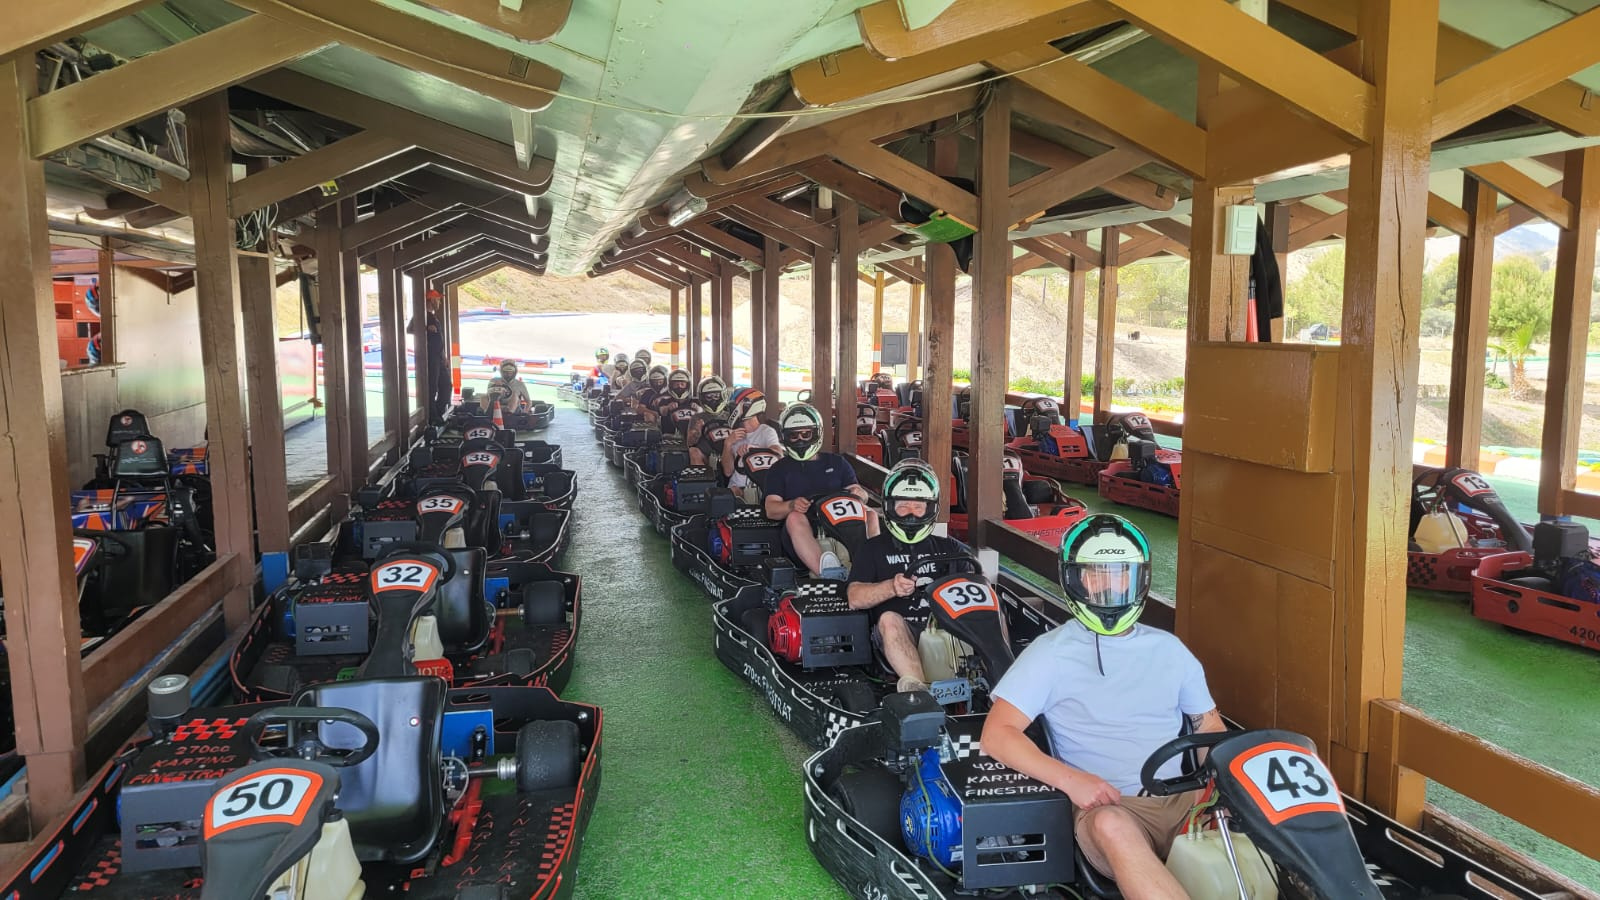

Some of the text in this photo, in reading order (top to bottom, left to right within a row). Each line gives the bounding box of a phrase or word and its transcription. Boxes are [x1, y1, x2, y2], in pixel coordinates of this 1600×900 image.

[679, 410, 692, 418] 34
[1130, 416, 1148, 425] 12
[470, 430, 488, 438] 45
[715, 429, 731, 437] 41
[469, 454, 490, 462] 38
[753, 456, 774, 466] 37
[1464, 476, 1490, 489] 13
[425, 498, 453, 509] 35
[832, 500, 859, 516] 51
[886, 554, 911, 565] WAIT
[383, 566, 422, 584] 32
[947, 584, 987, 606] 39
[175, 745, 231, 755] 270cc
[151, 755, 237, 768] KARTING
[972, 762, 1006, 771] 420
[967, 773, 1029, 784] KARTIN
[1266, 756, 1329, 798] 43
[222, 778, 295, 817] 50
